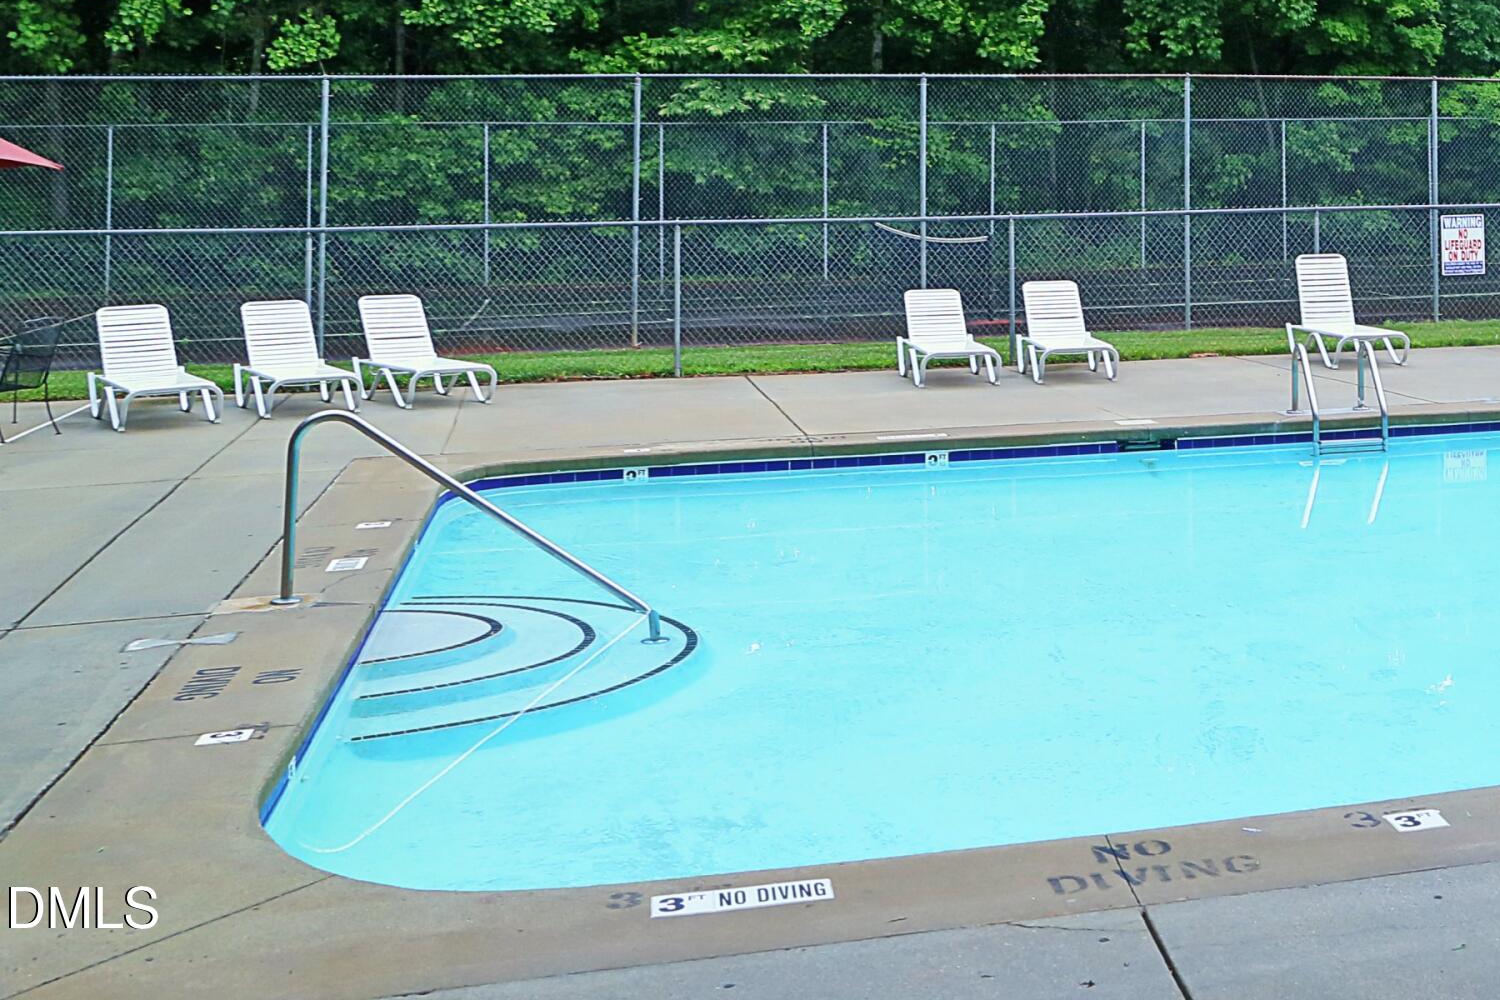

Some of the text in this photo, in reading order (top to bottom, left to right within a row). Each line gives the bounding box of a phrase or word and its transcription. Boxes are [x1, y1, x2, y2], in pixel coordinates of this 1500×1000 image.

[1443, 217, 1482, 228] WARNING
[1458, 229, 1468, 239] NO
[1445, 239, 1482, 250] LIFEGUARD
[1449, 250, 1478, 261] ON DUTY
[1343, 811, 1381, 828] 3
[1395, 815, 1421, 828] 3
[1092, 839, 1171, 863] NO
[1047, 855, 1261, 895] DIVING
[659, 897, 685, 912] 3
[719, 890, 746, 907] NO
[757, 882, 827, 902] DIVING
